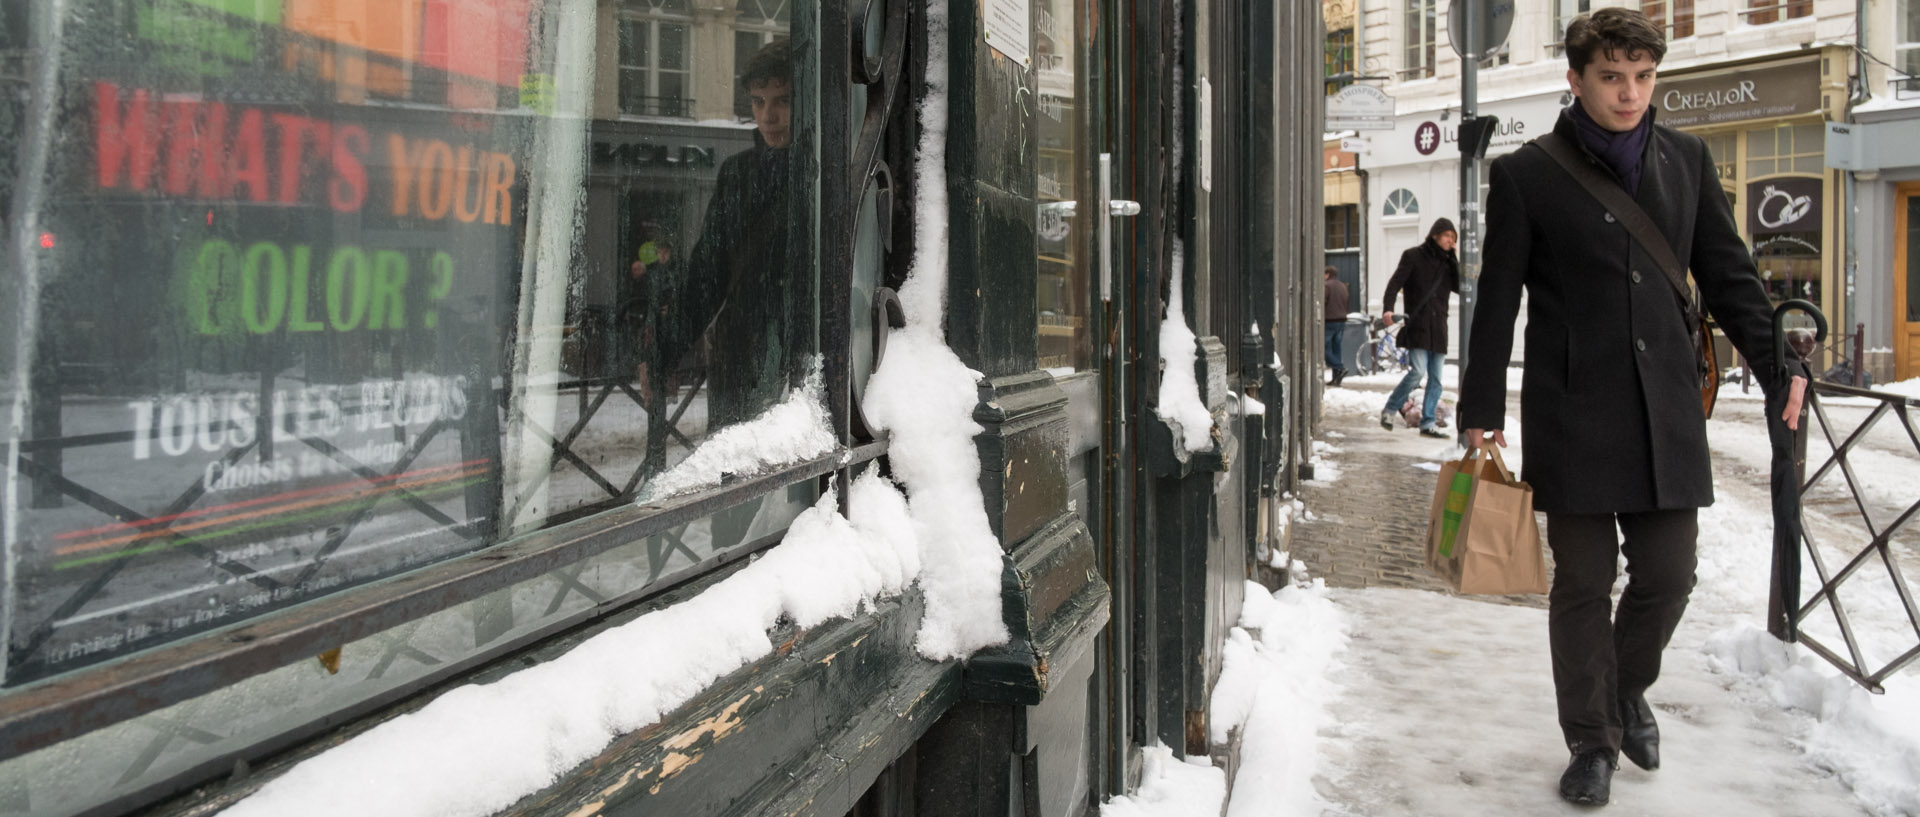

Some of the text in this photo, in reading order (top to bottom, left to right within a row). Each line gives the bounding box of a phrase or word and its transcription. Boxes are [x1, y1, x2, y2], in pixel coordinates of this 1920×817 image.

[95, 80, 516, 226] WHAT'S YOUR
[193, 238, 409, 336] COLOR
[129, 374, 467, 460] TOUS LES JEUDIS
[204, 454, 294, 493] Choisis
